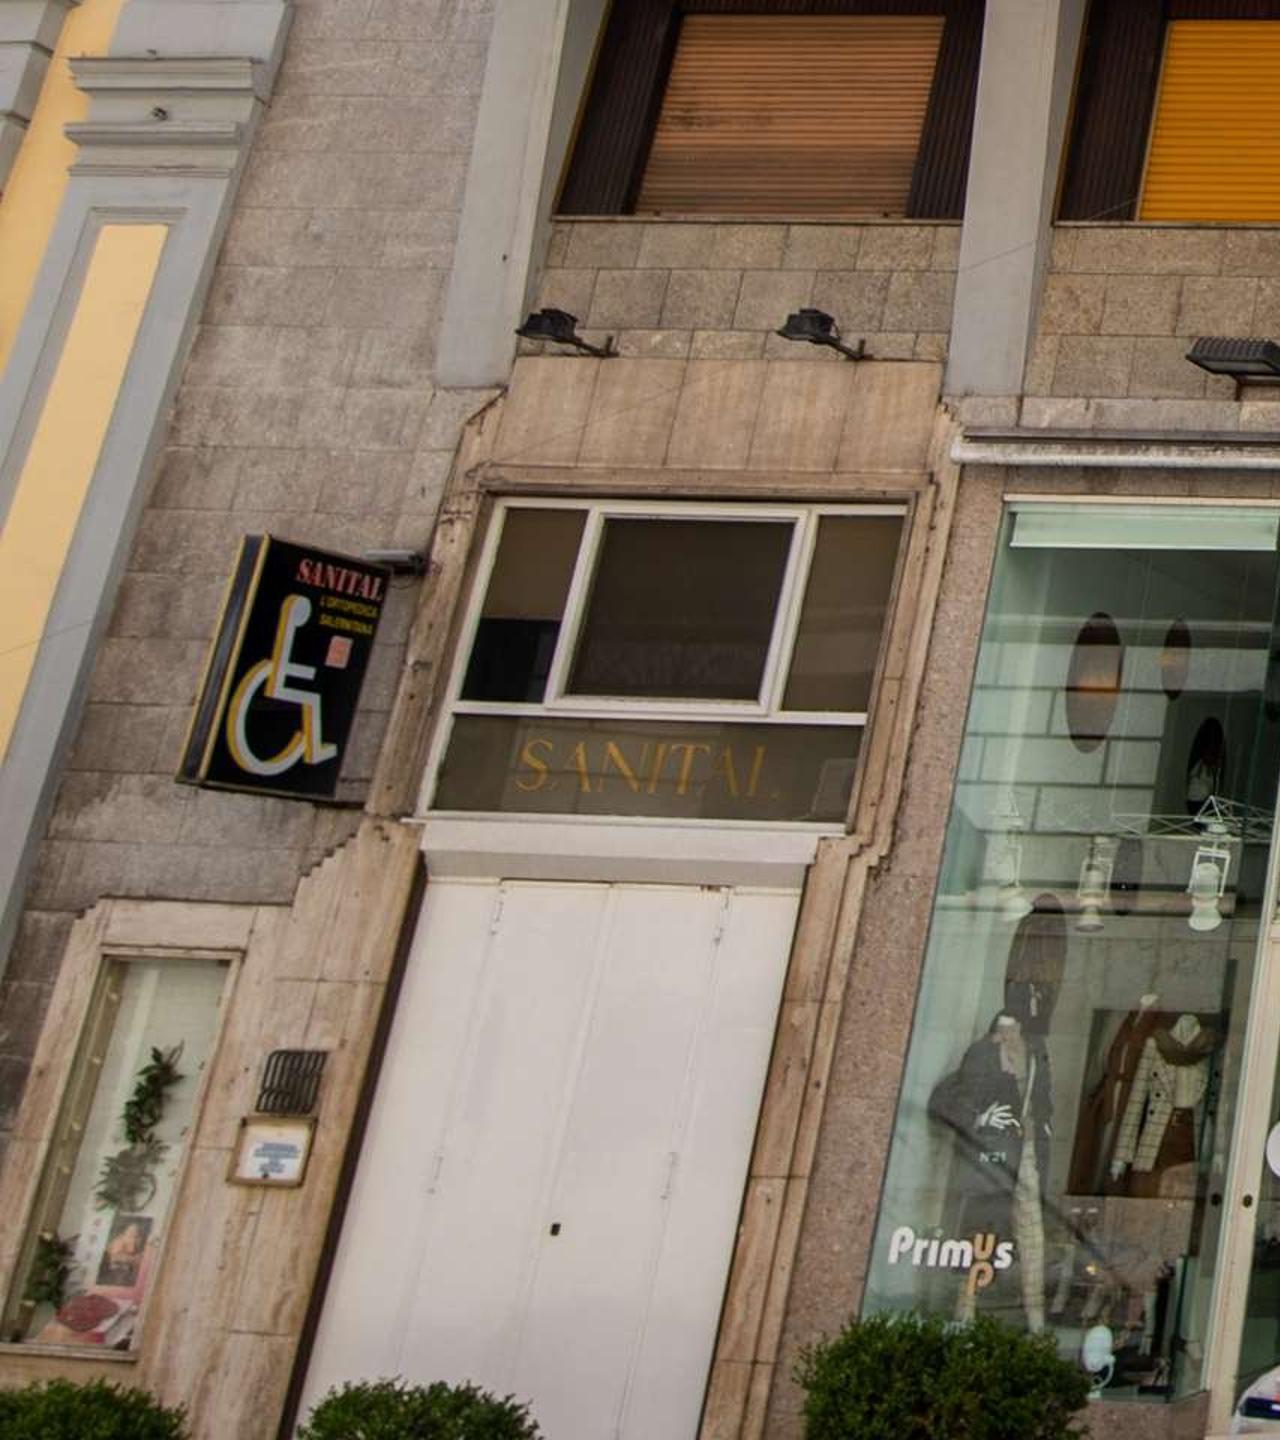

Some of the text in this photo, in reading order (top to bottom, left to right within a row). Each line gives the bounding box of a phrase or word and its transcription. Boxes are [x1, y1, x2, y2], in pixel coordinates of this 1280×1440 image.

[296, 558, 382, 601] SANITAL
[514, 739, 779, 797] SANITAL
[888, 1225, 1015, 1269] Primus
